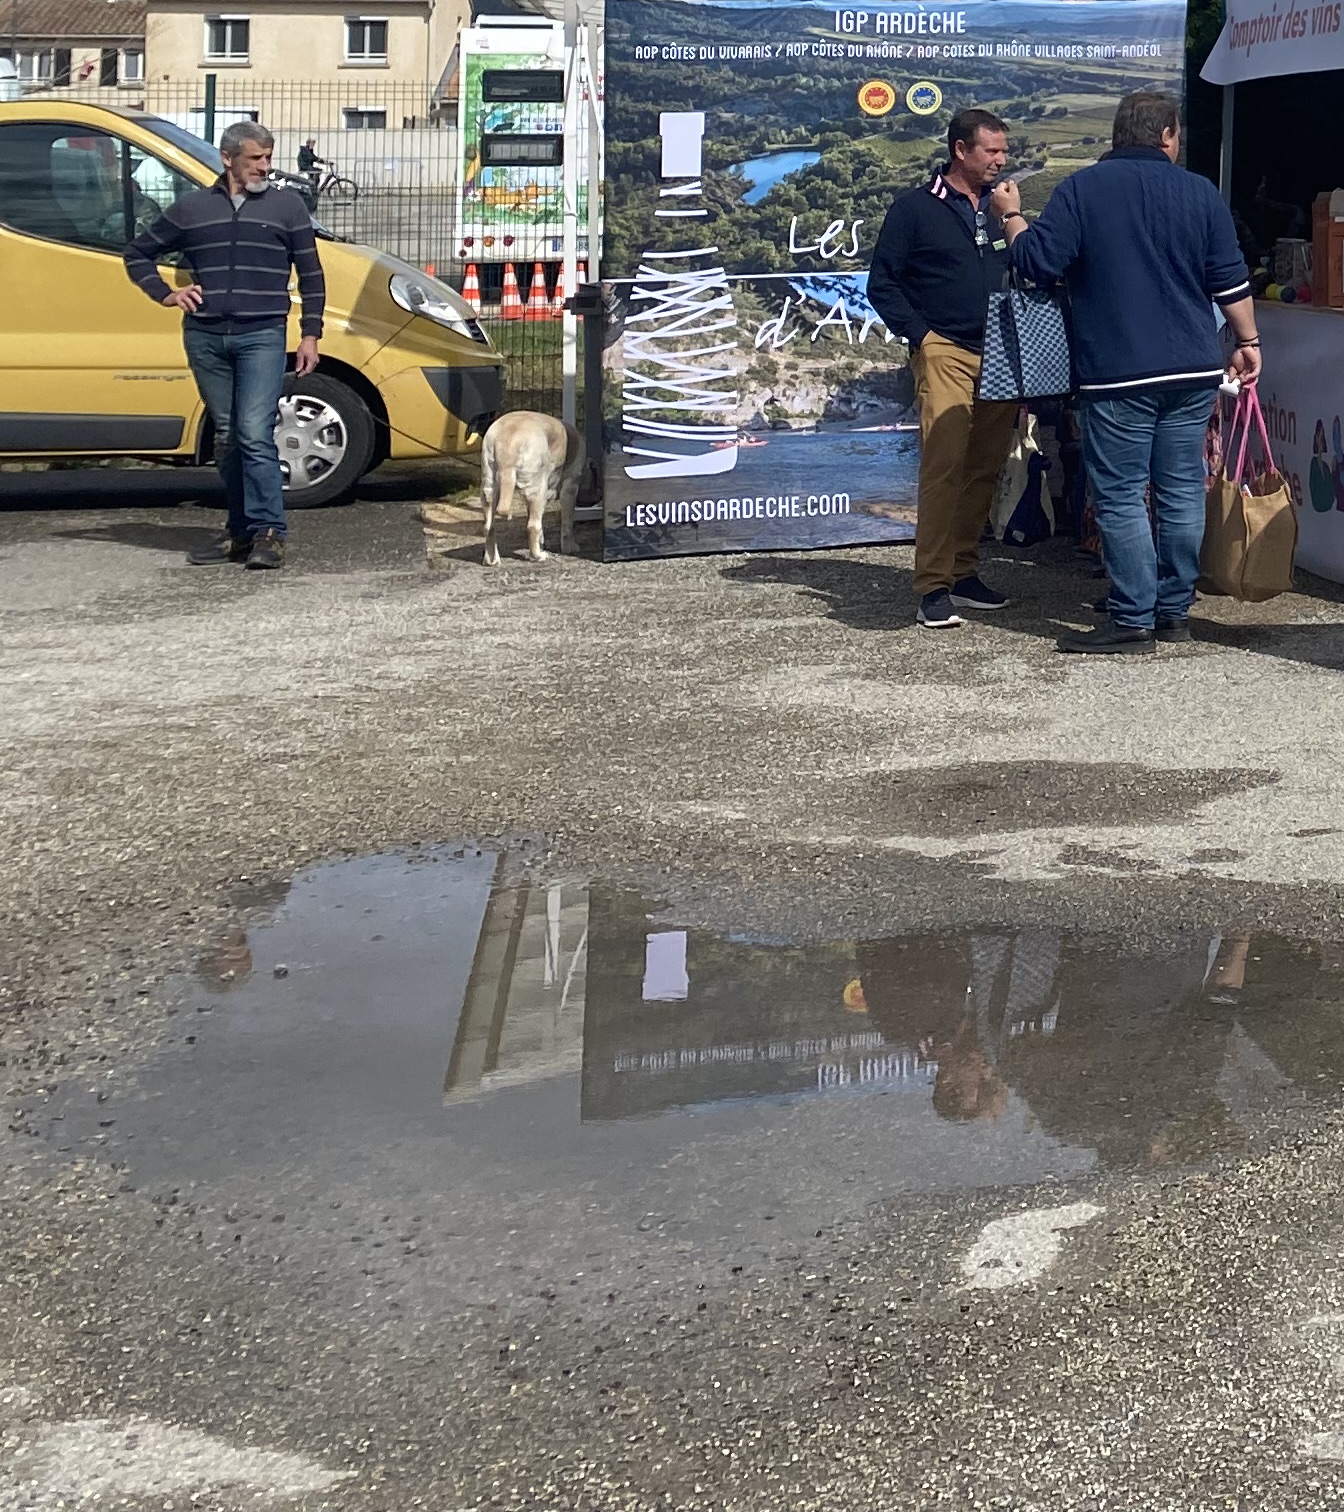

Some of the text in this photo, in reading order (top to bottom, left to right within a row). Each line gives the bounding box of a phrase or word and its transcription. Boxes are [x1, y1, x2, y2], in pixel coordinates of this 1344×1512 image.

[835, 4, 966, 34] IGP ARDÈCHE
[1282, 0, 1309, 39] des
[635, 45, 659, 59] AOP
[661, 42, 696, 60] CÔTES
[699, 45, 715, 60] DU
[719, 44, 772, 60] VIVARAIS
[786, 42, 809, 57] AOP
[811, 39, 844, 58] CÔTES
[847, 44, 863, 58] DU
[866, 41, 902, 59] RHÔNE
[917, 44, 939, 58] AOP
[978, 44, 993, 57] DU
[996, 40, 1031, 57] RHÔNE
[1035, 44, 1083, 58] VILLAGES
[1086, 39, 1162, 58] SAINT-ANDÉOL
[788, 215, 864, 259] Les
[626, 492, 850, 528] LESVINSDARDECHE.COM
